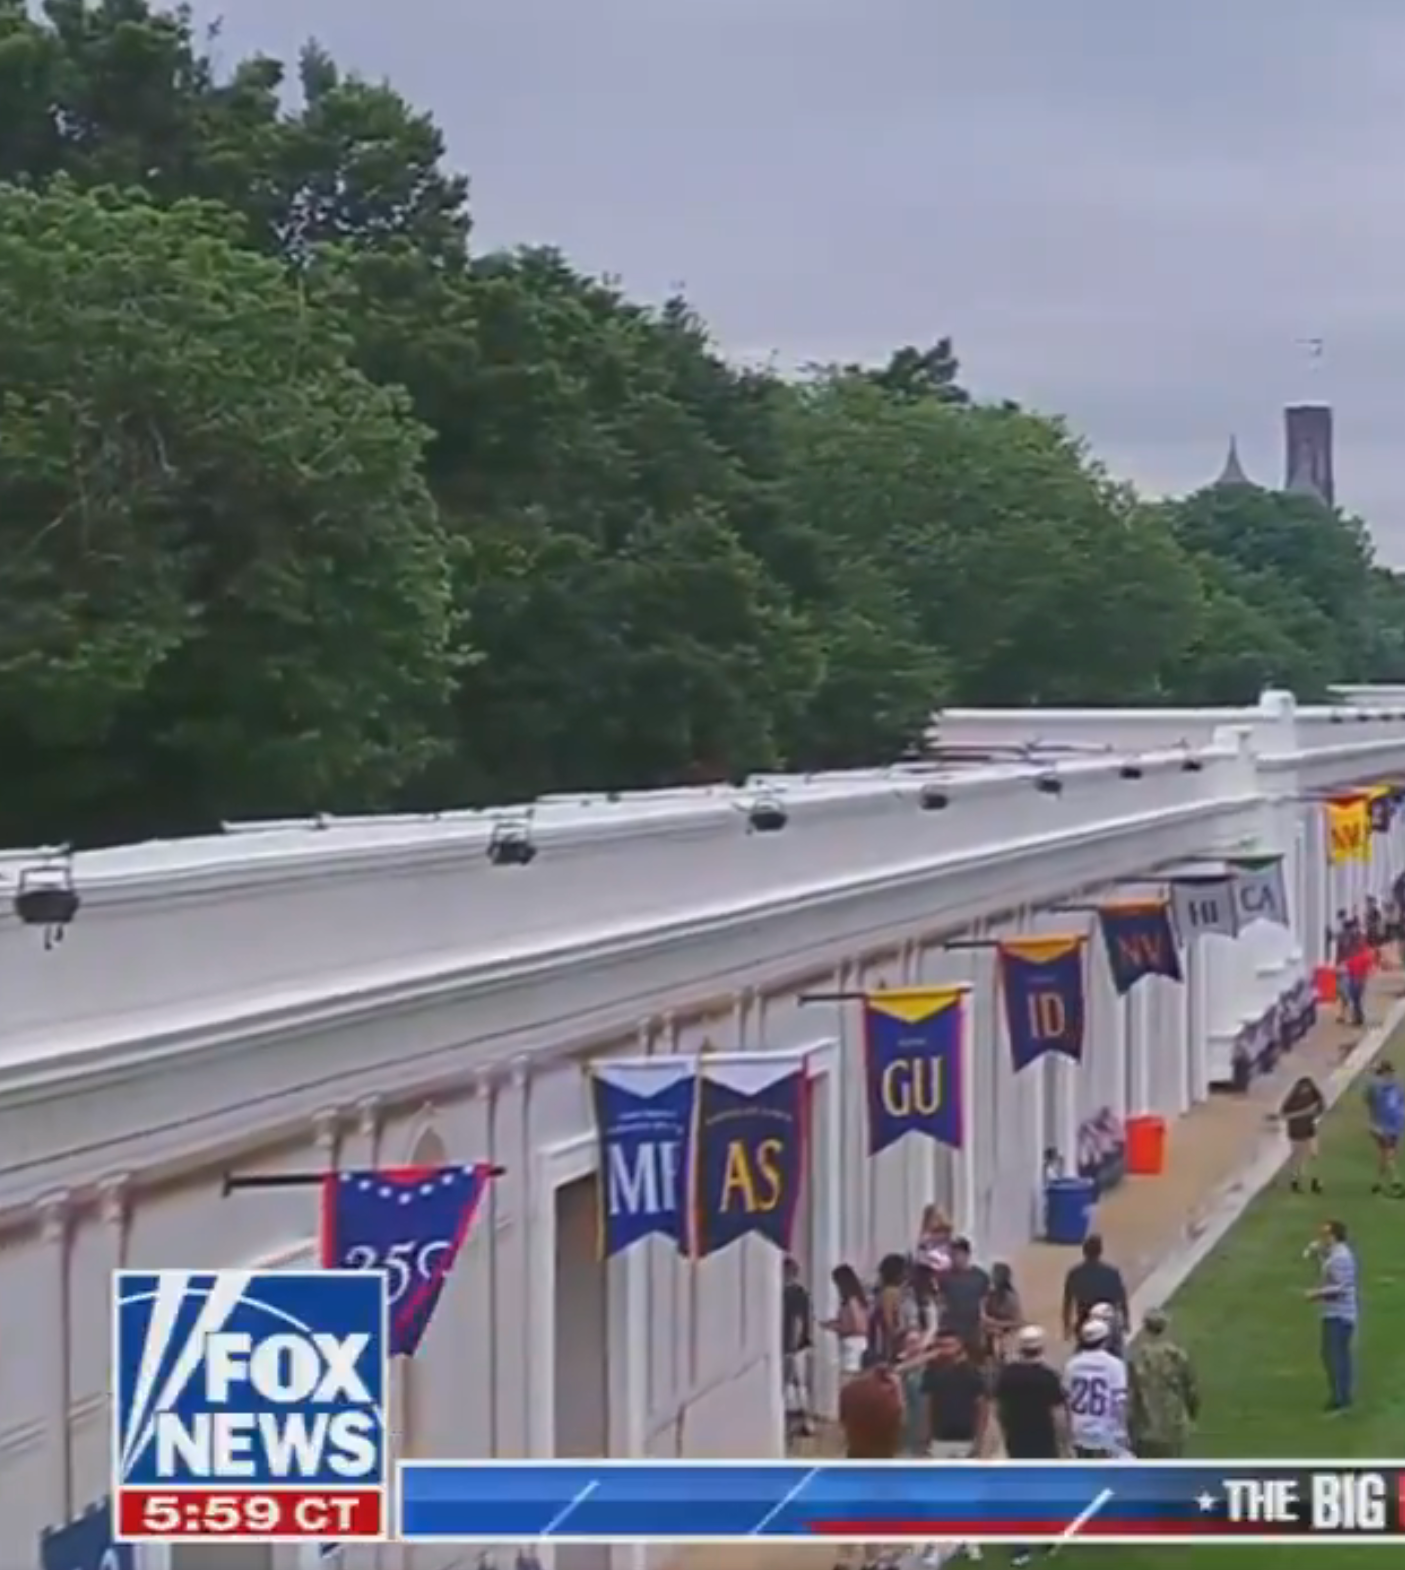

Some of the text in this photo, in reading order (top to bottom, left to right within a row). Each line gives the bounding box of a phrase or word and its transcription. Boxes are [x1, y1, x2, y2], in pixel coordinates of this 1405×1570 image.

[1187, 899, 1219, 928] HI
[1240, 884, 1277, 912] CA
[1027, 992, 1066, 1038] ID
[882, 1056, 943, 1117] GU
[718, 1138, 784, 1214] AS
[1070, 1376, 1108, 1417] 26
